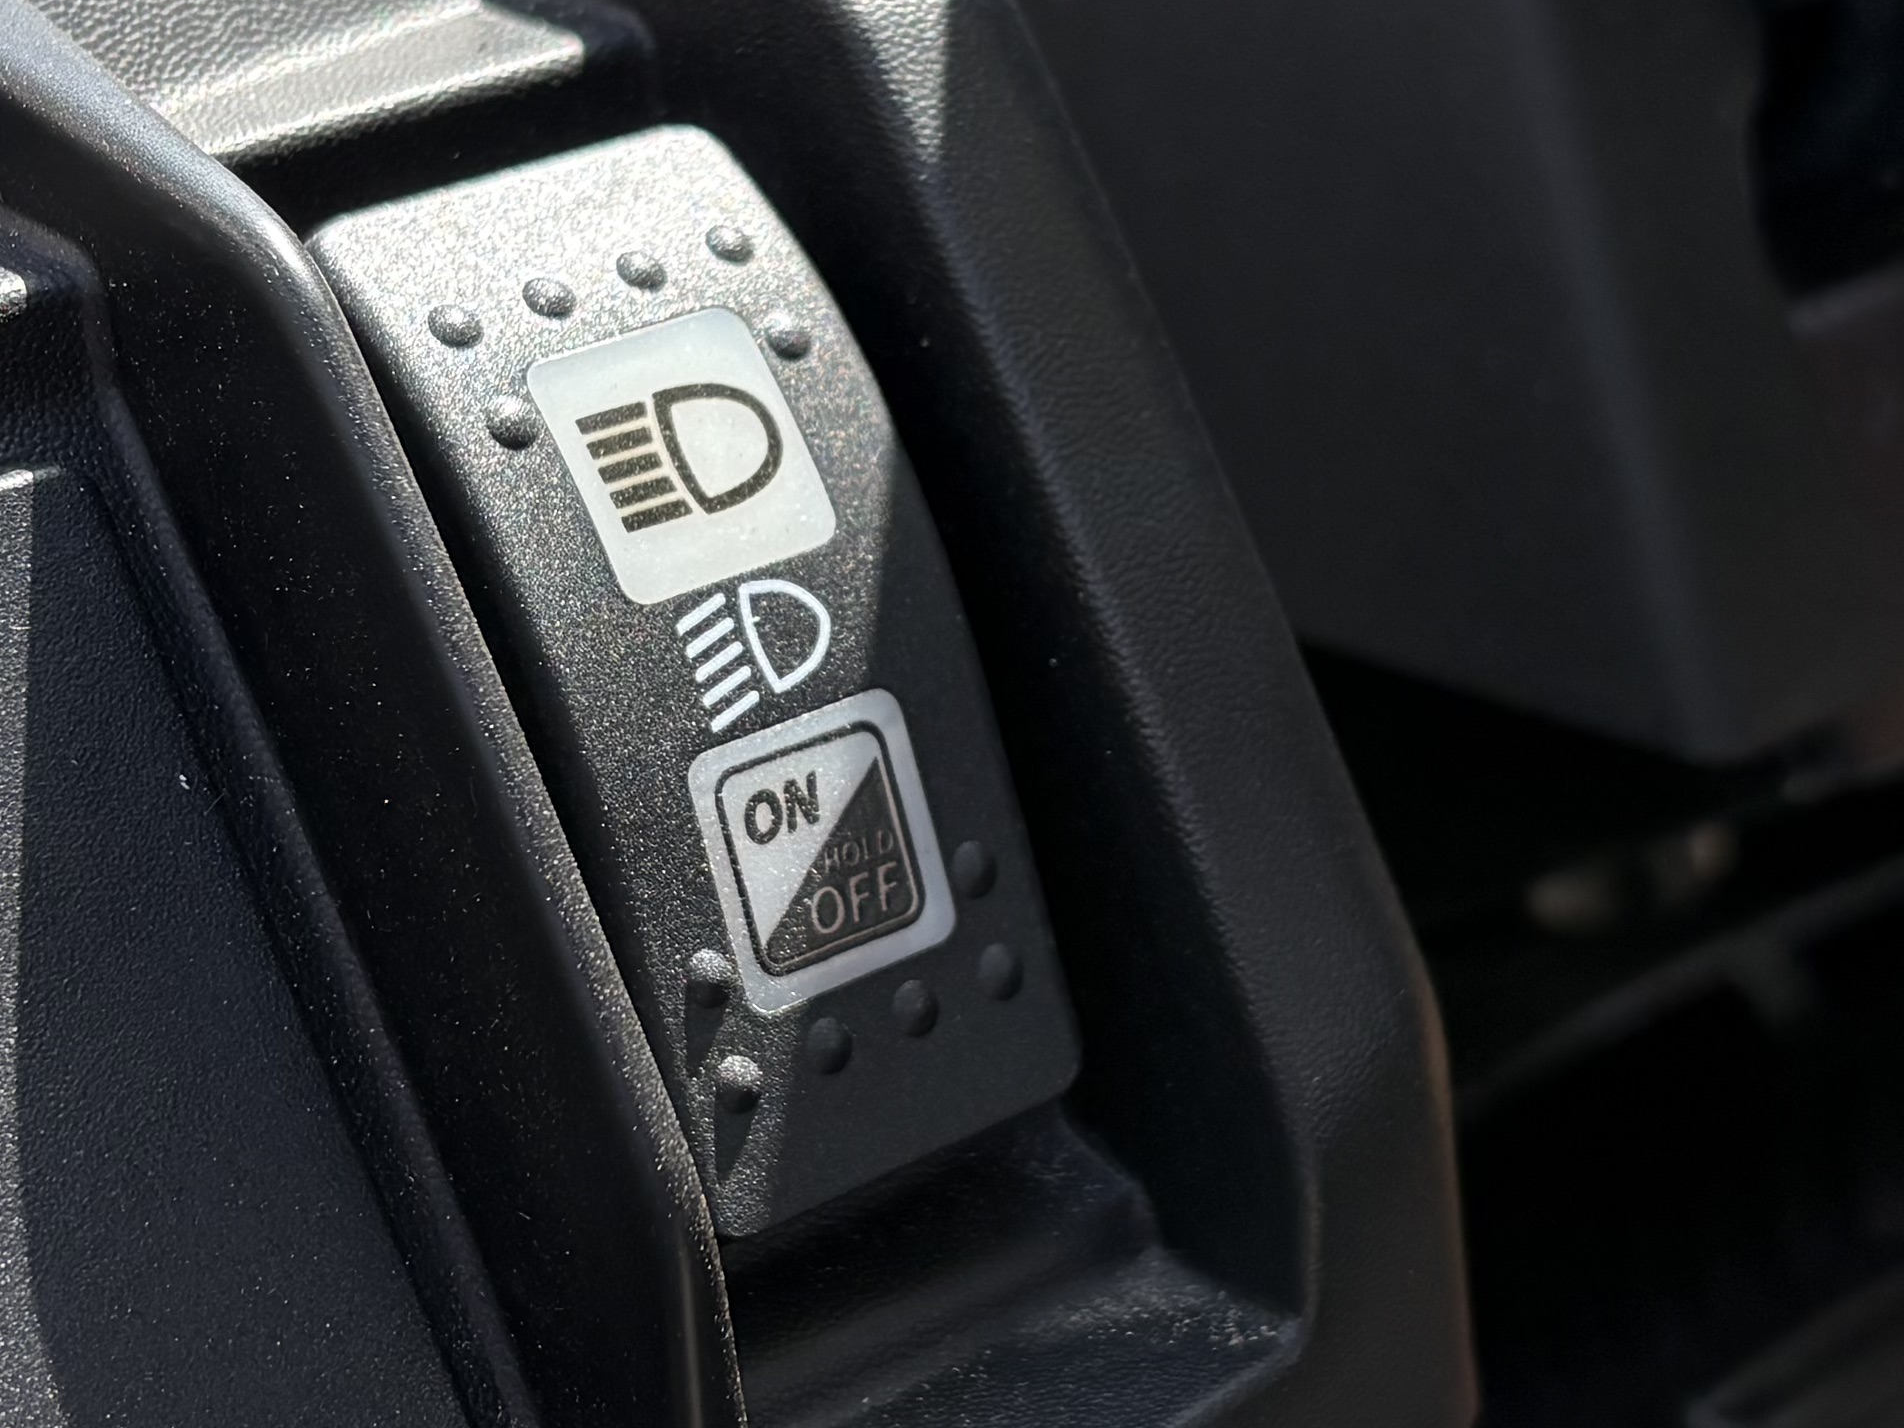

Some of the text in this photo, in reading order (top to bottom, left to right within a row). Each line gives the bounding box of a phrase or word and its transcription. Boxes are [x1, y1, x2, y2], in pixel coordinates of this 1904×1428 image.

[744, 770, 821, 845] ON
[823, 829, 894, 873] HOLD
[811, 861, 897, 934] OFF
